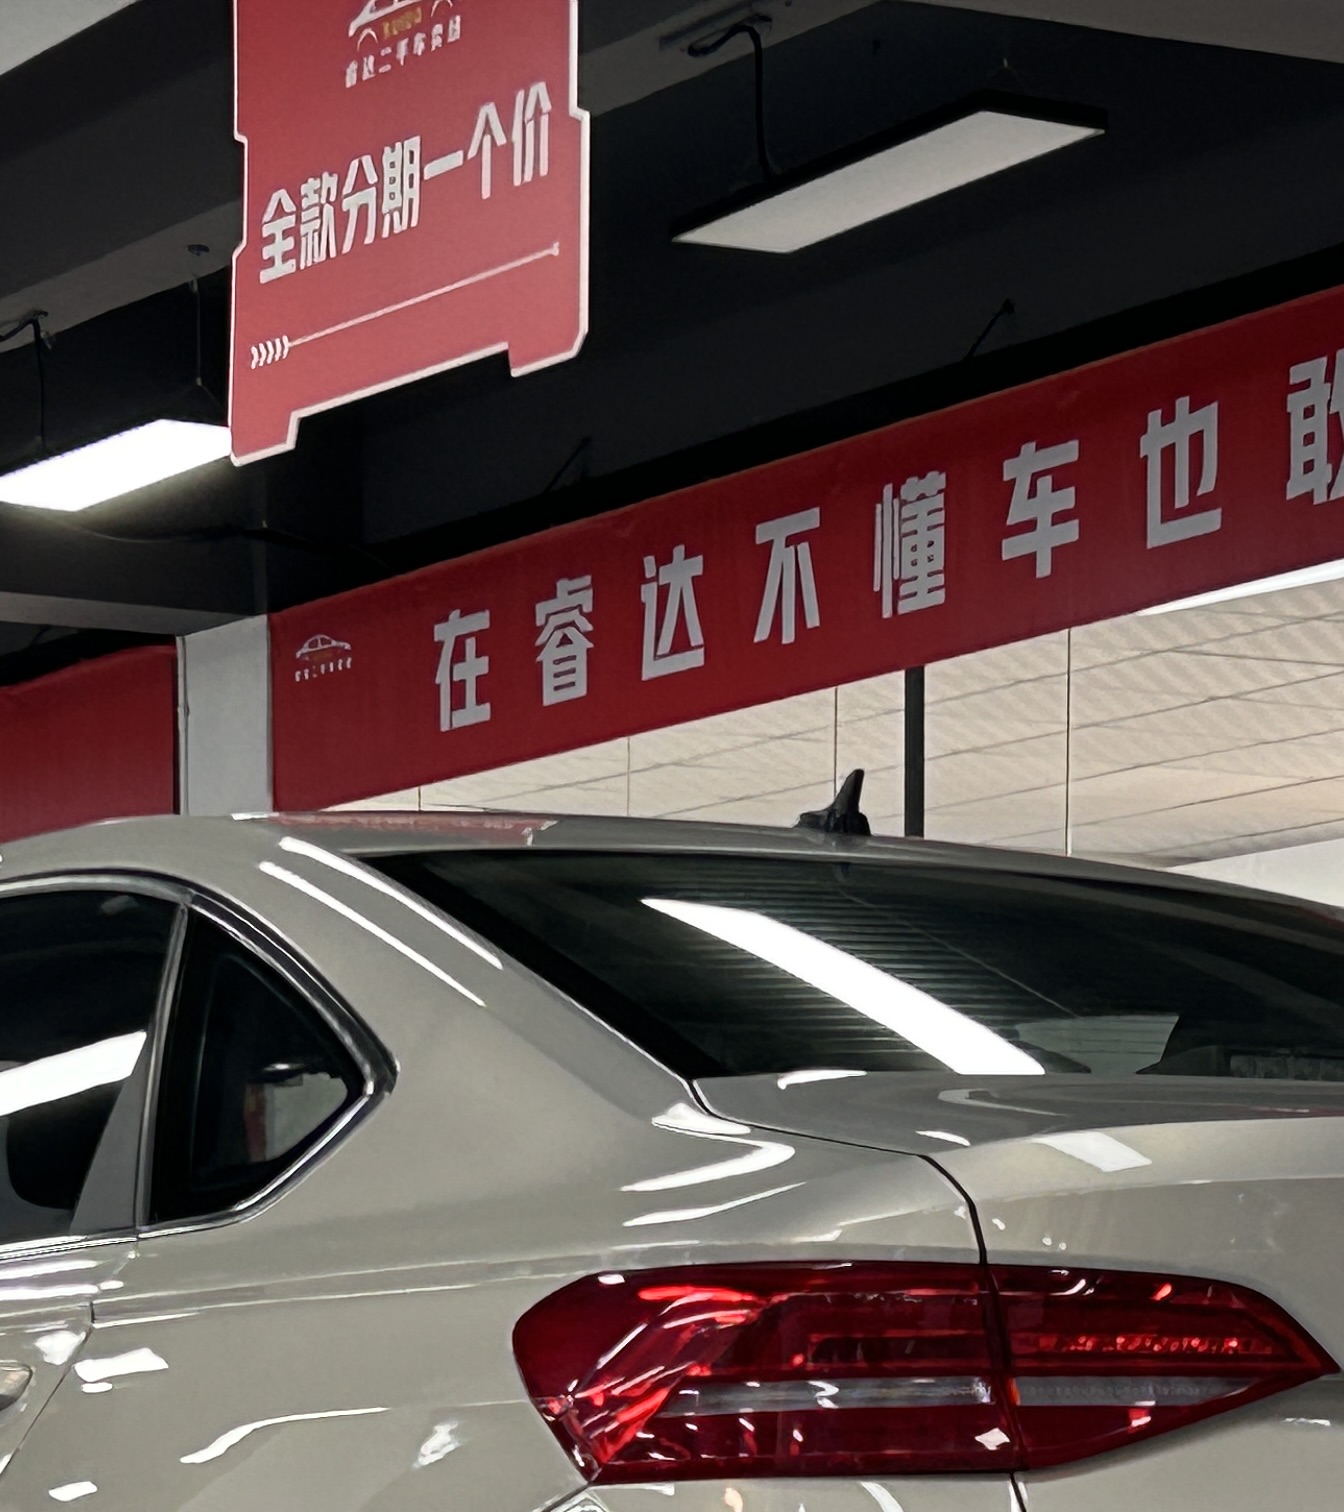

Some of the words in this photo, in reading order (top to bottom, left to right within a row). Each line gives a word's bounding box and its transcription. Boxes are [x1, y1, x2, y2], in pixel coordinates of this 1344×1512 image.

[259, 82, 552, 284] 全款分期一个价
